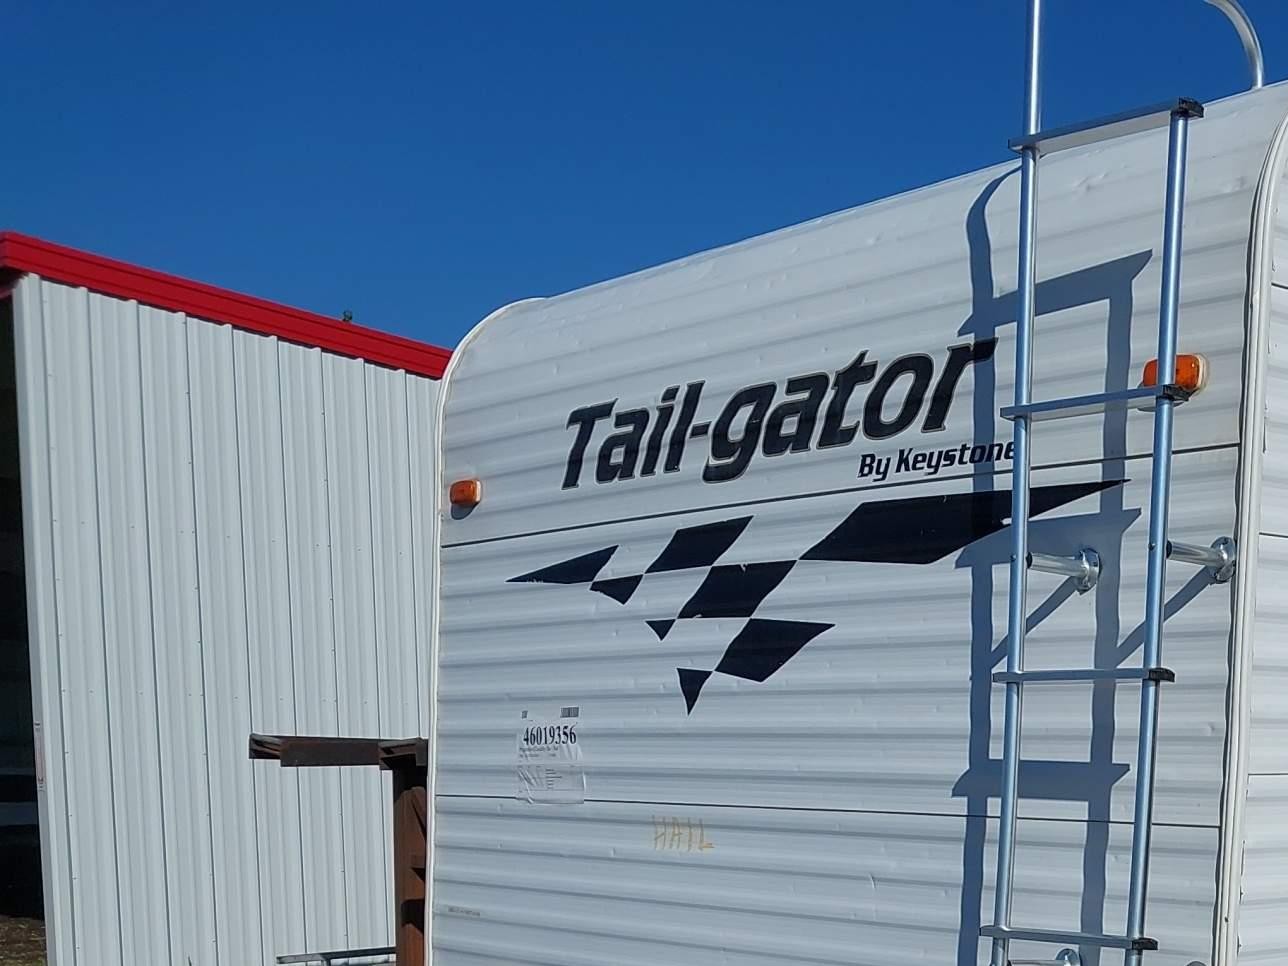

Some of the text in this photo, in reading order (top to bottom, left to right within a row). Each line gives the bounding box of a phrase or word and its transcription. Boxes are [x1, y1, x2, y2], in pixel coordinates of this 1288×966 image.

[561, 337, 998, 490] Tail-gator
[857, 441, 1015, 481] By Keystone
[523, 724, 577, 746] 46019356
